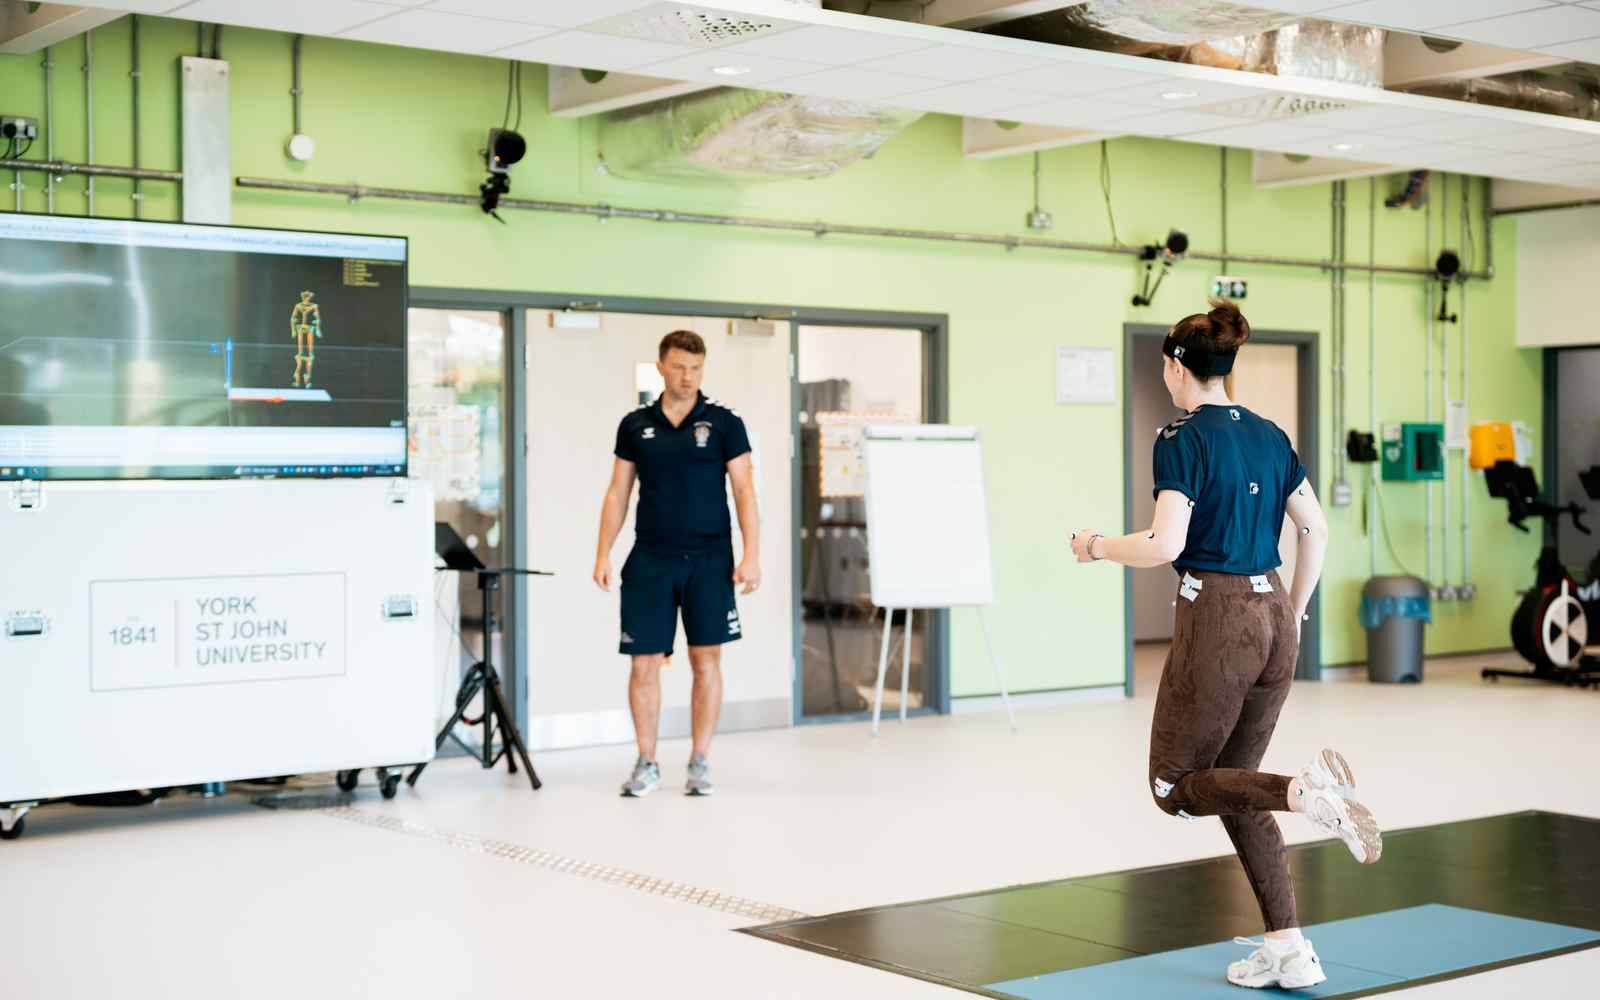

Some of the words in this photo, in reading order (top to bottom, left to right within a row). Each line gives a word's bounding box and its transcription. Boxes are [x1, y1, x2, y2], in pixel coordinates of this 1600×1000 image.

[196, 597, 257, 616] YORK
[109, 627, 157, 646] 1841
[196, 622, 224, 641] ST
[231, 620, 288, 640] JOHN
[196, 641, 327, 666] UNIVERSITY
